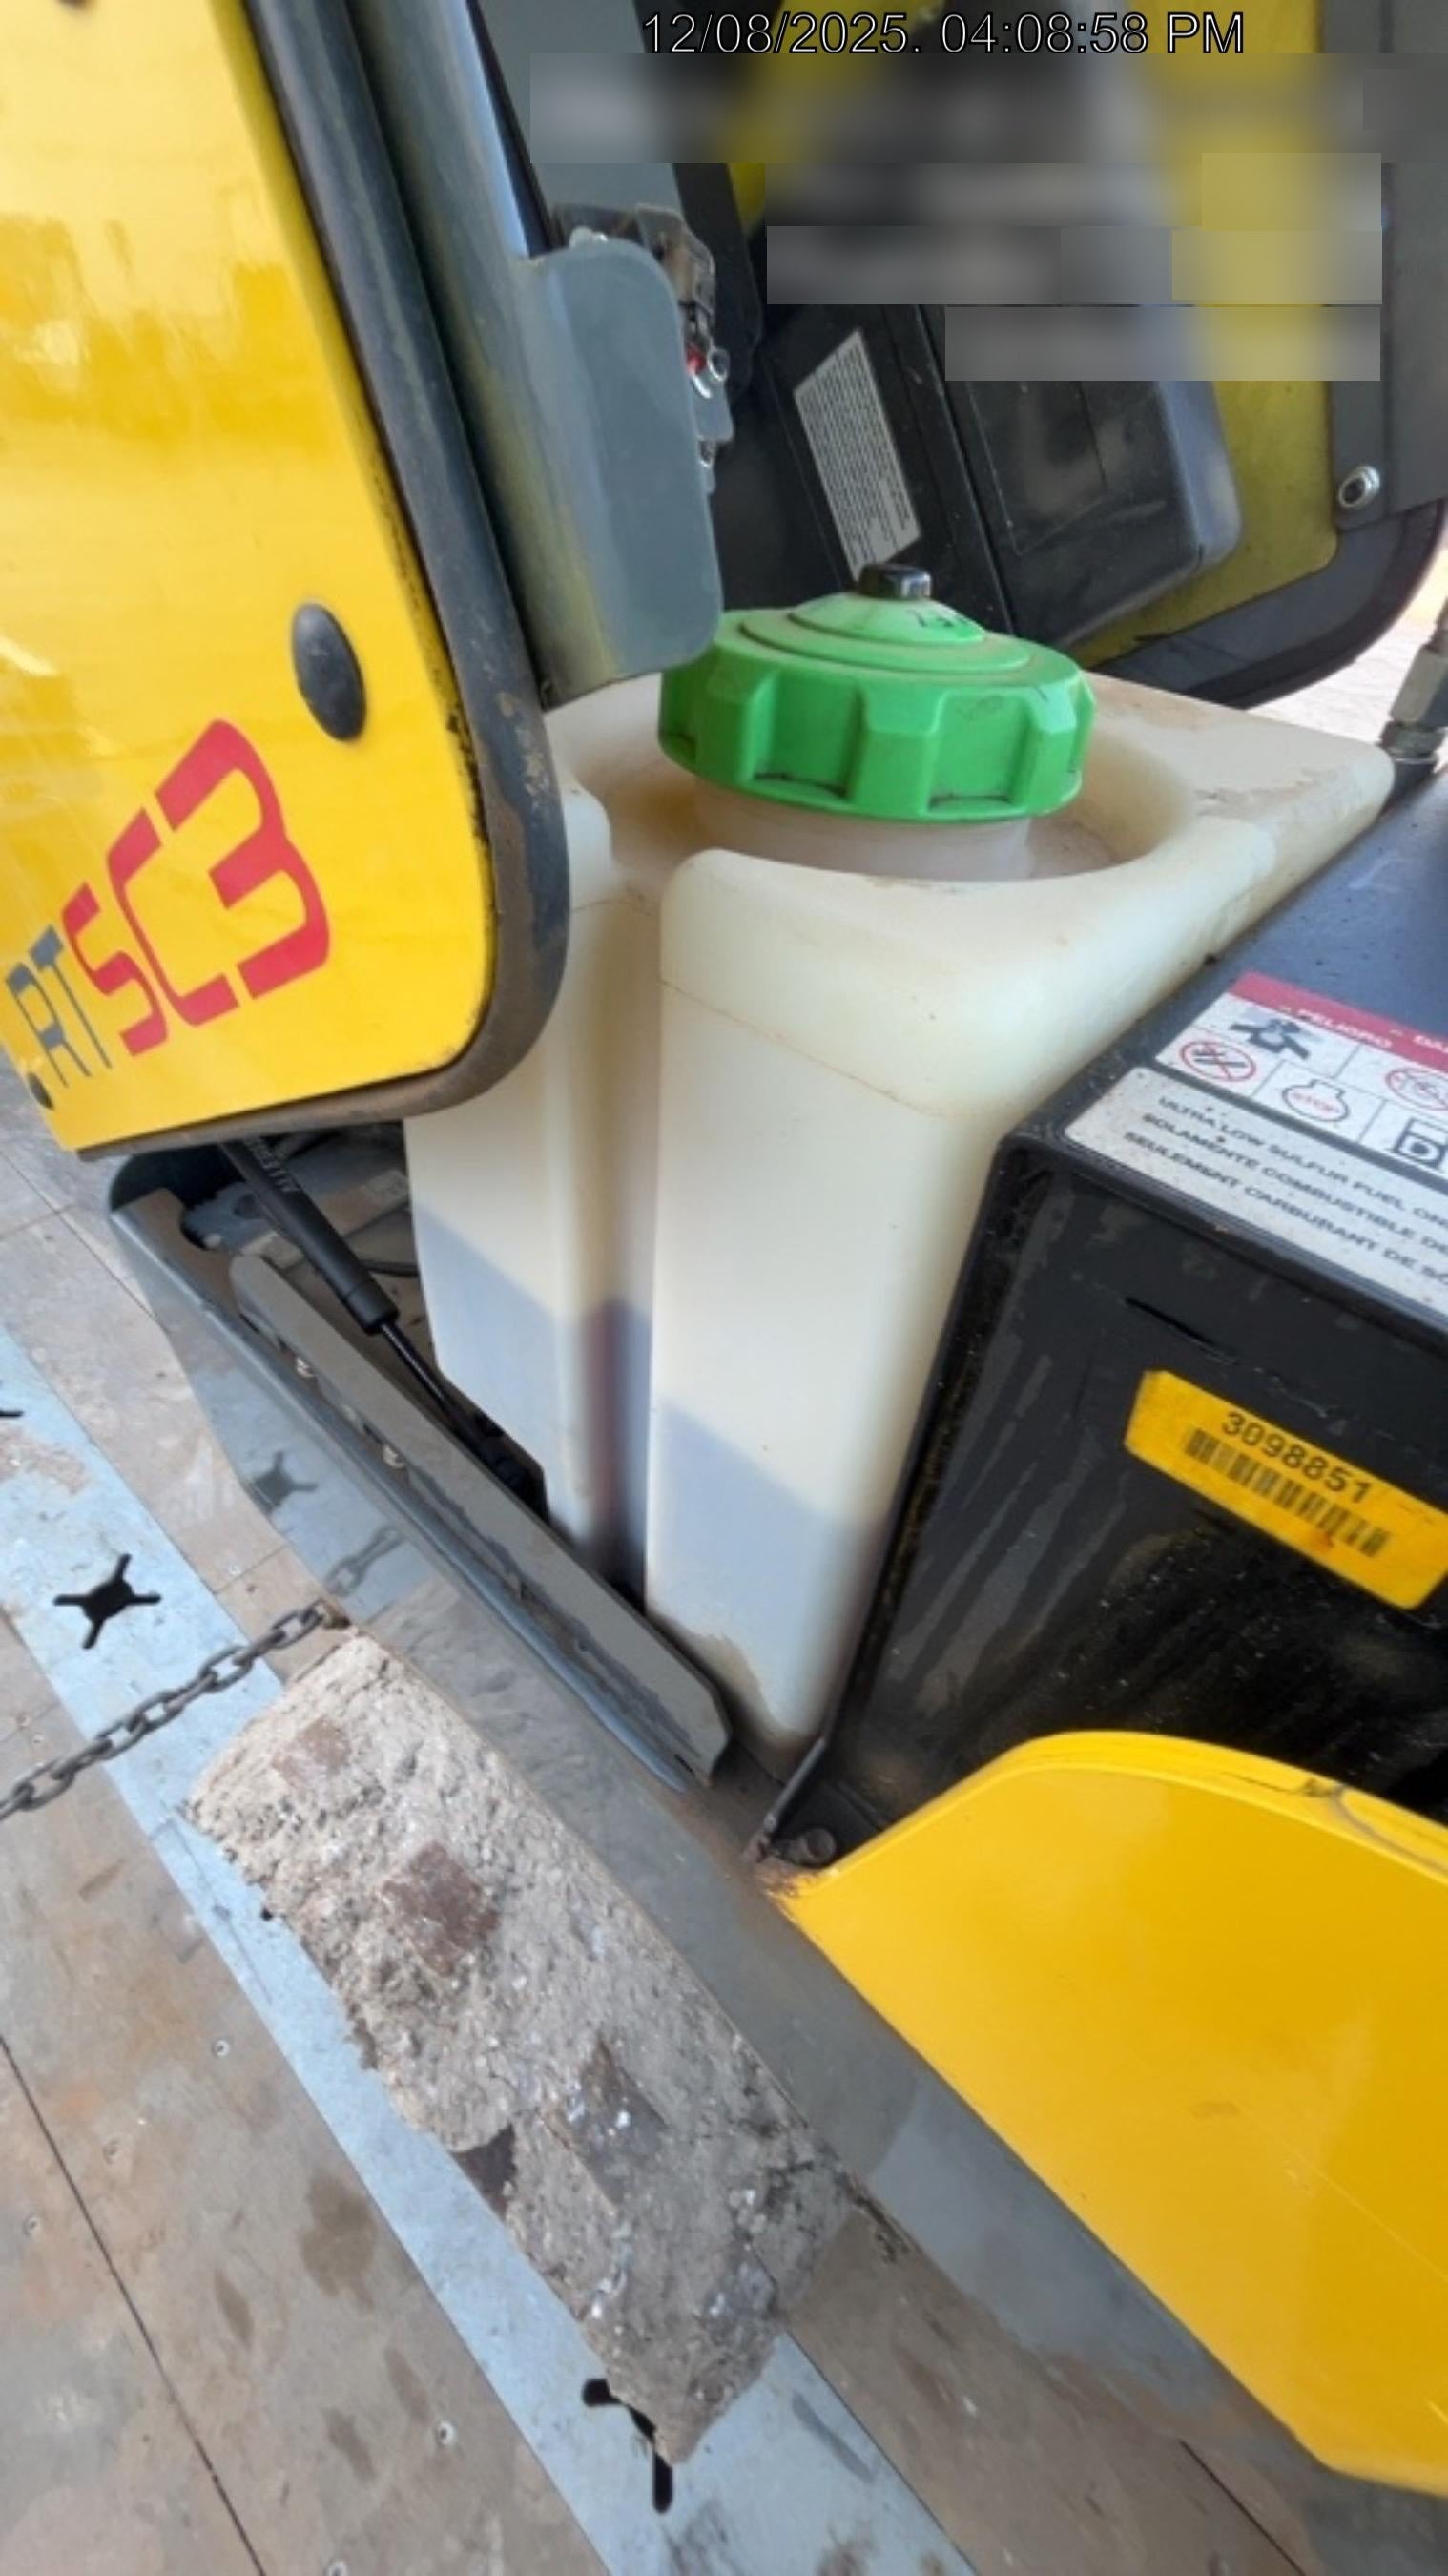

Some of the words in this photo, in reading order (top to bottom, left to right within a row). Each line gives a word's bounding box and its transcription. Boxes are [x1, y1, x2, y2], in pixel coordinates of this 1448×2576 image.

[1297, 1008, 1393, 1049] PELIGRO
[1124, 1131, 1240, 1188] SEULEMENT
[1244, 1186, 1378, 1251] CARBURANT
[1383, 1248, 1417, 1270] DE
[1142, 1112, 1259, 1169] SOLAMENTE
[1262, 1166, 1416, 1238] COMBUSTIBLE
[1158, 1097, 1215, 1128] ULTRA
[1220, 1123, 1265, 1146] LOW
[1269, 1144, 1348, 1183] SULFUR
[1353, 1181, 1405, 1211] FUEL
[1221, 1410, 1374, 1504] 3098851
